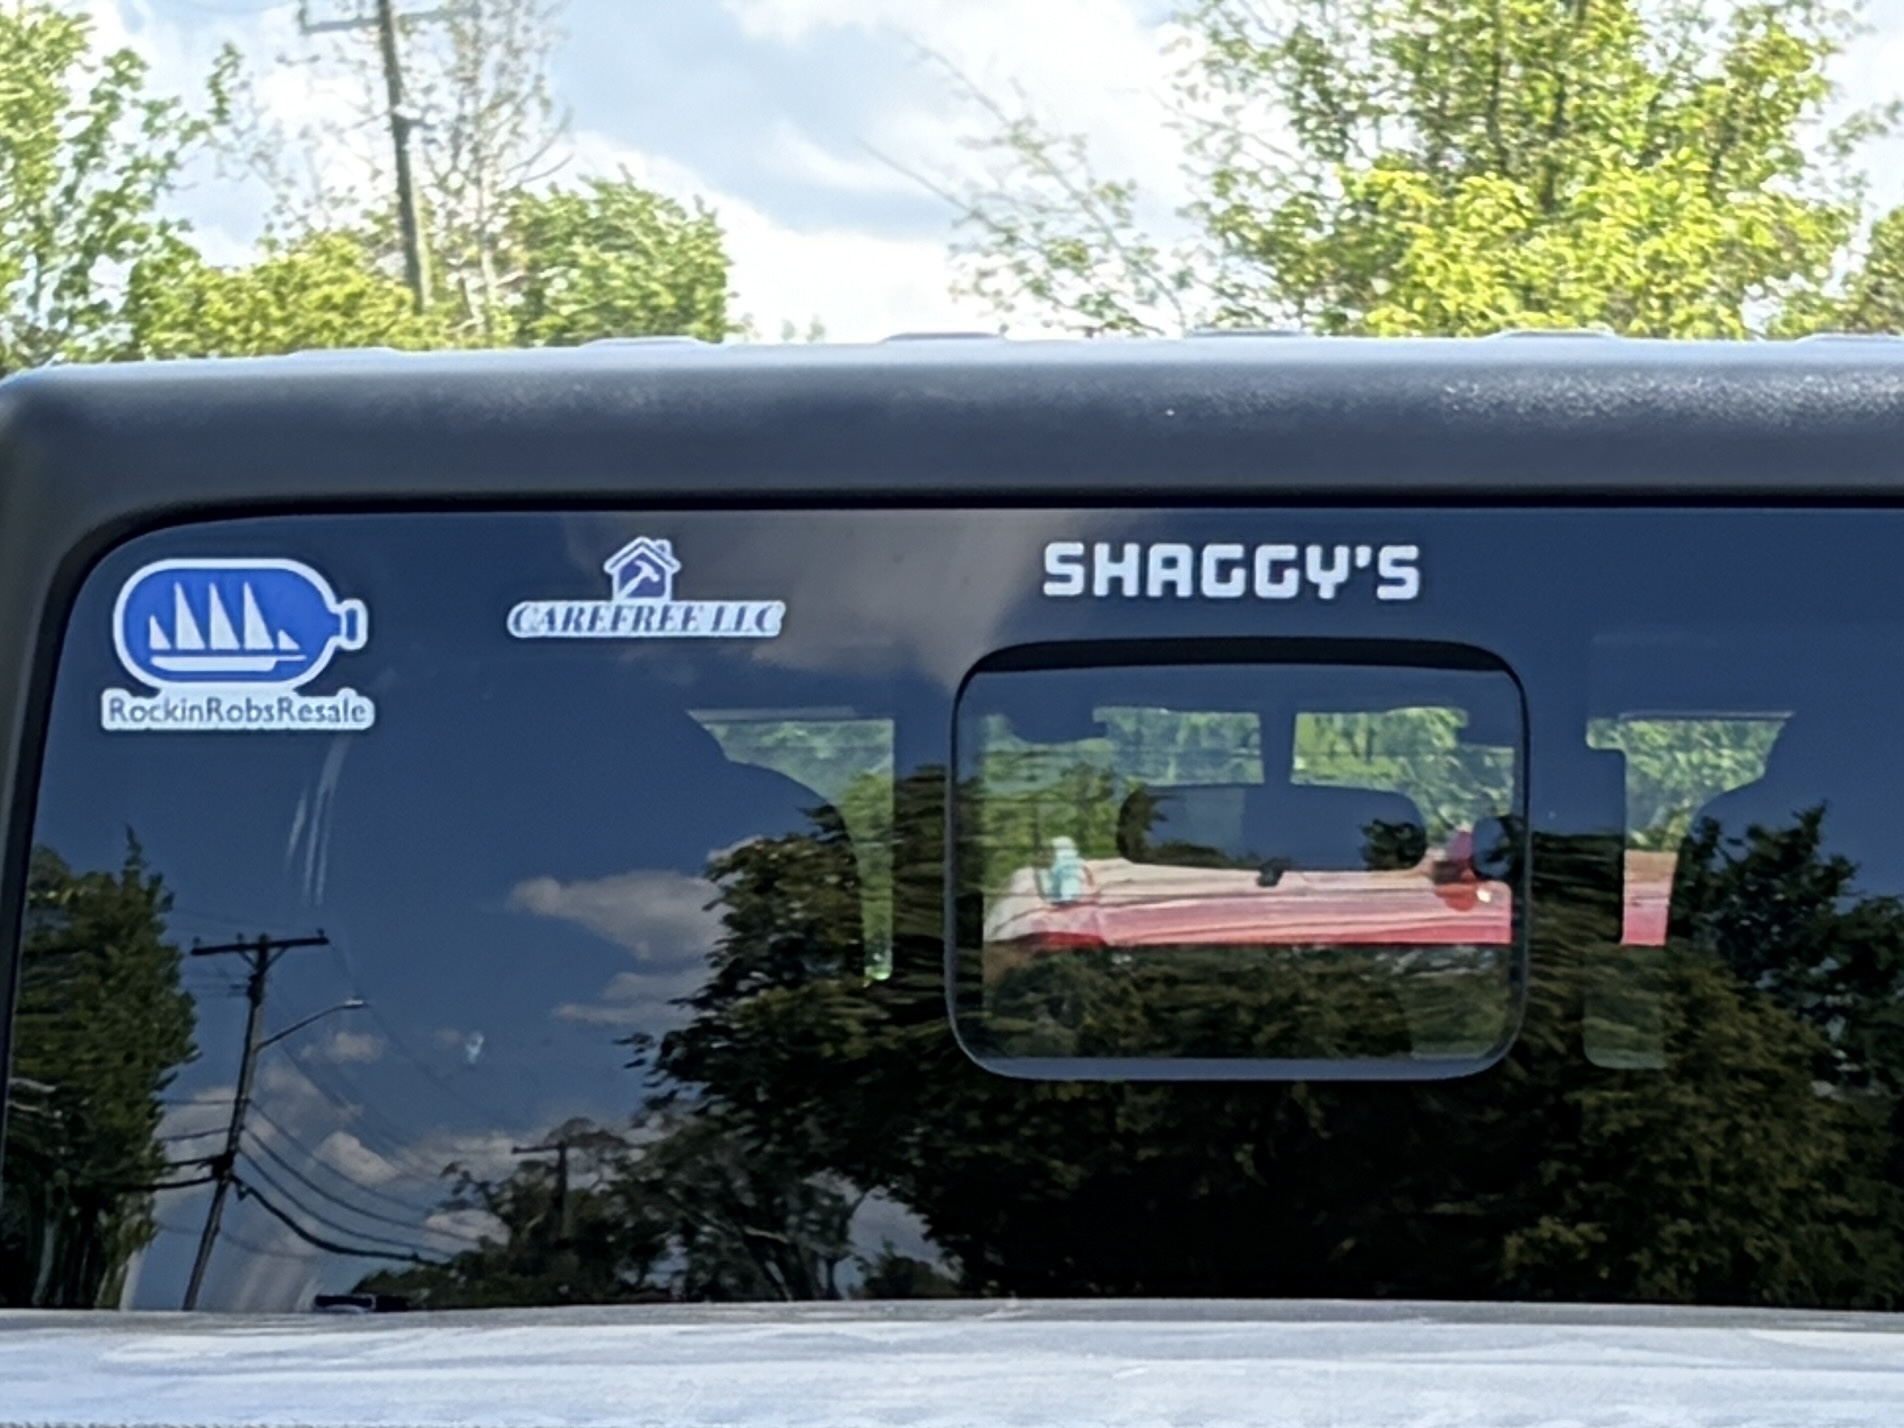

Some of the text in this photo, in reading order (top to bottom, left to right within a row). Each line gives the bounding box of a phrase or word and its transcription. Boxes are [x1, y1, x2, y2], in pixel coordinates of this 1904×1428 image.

[1043, 541, 1421, 600] SHAGGY'S
[512, 604, 777, 633] CAREFREE LLC
[108, 695, 368, 724] RockinRobsResale
